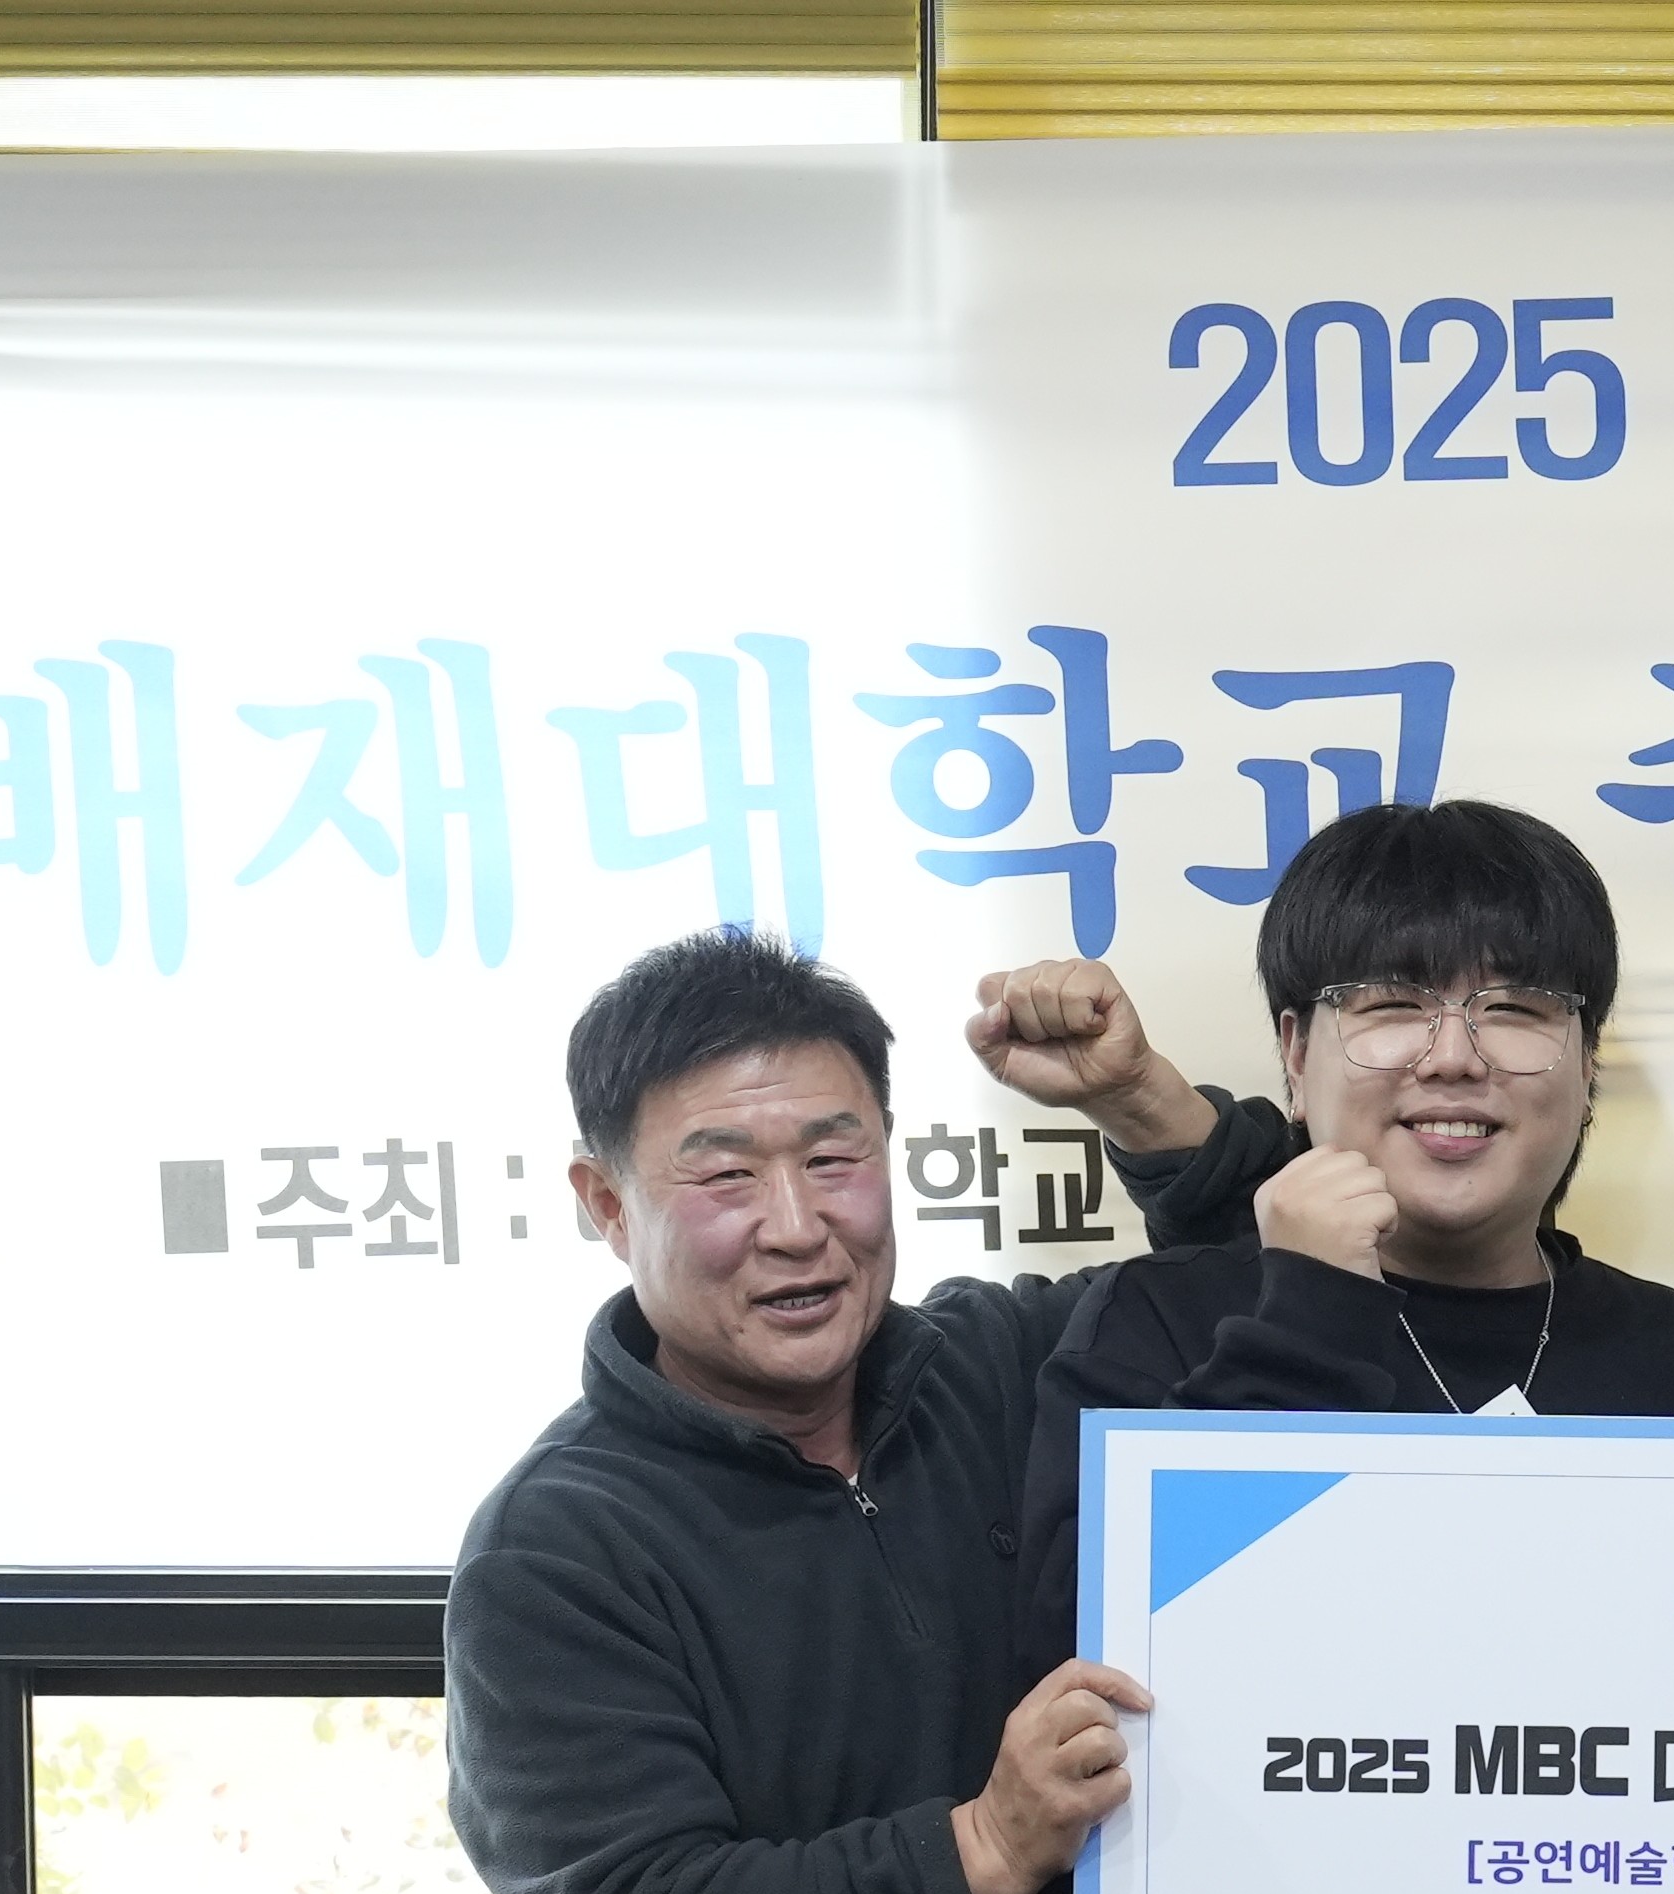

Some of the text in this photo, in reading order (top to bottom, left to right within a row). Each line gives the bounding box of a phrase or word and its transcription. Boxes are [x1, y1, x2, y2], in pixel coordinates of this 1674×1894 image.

[1168, 298, 1627, 488] 2025
[255, 1137, 461, 1270] 주최
[1262, 1737, 1430, 1794] 2025
[1454, 1724, 1630, 1798] MBC
